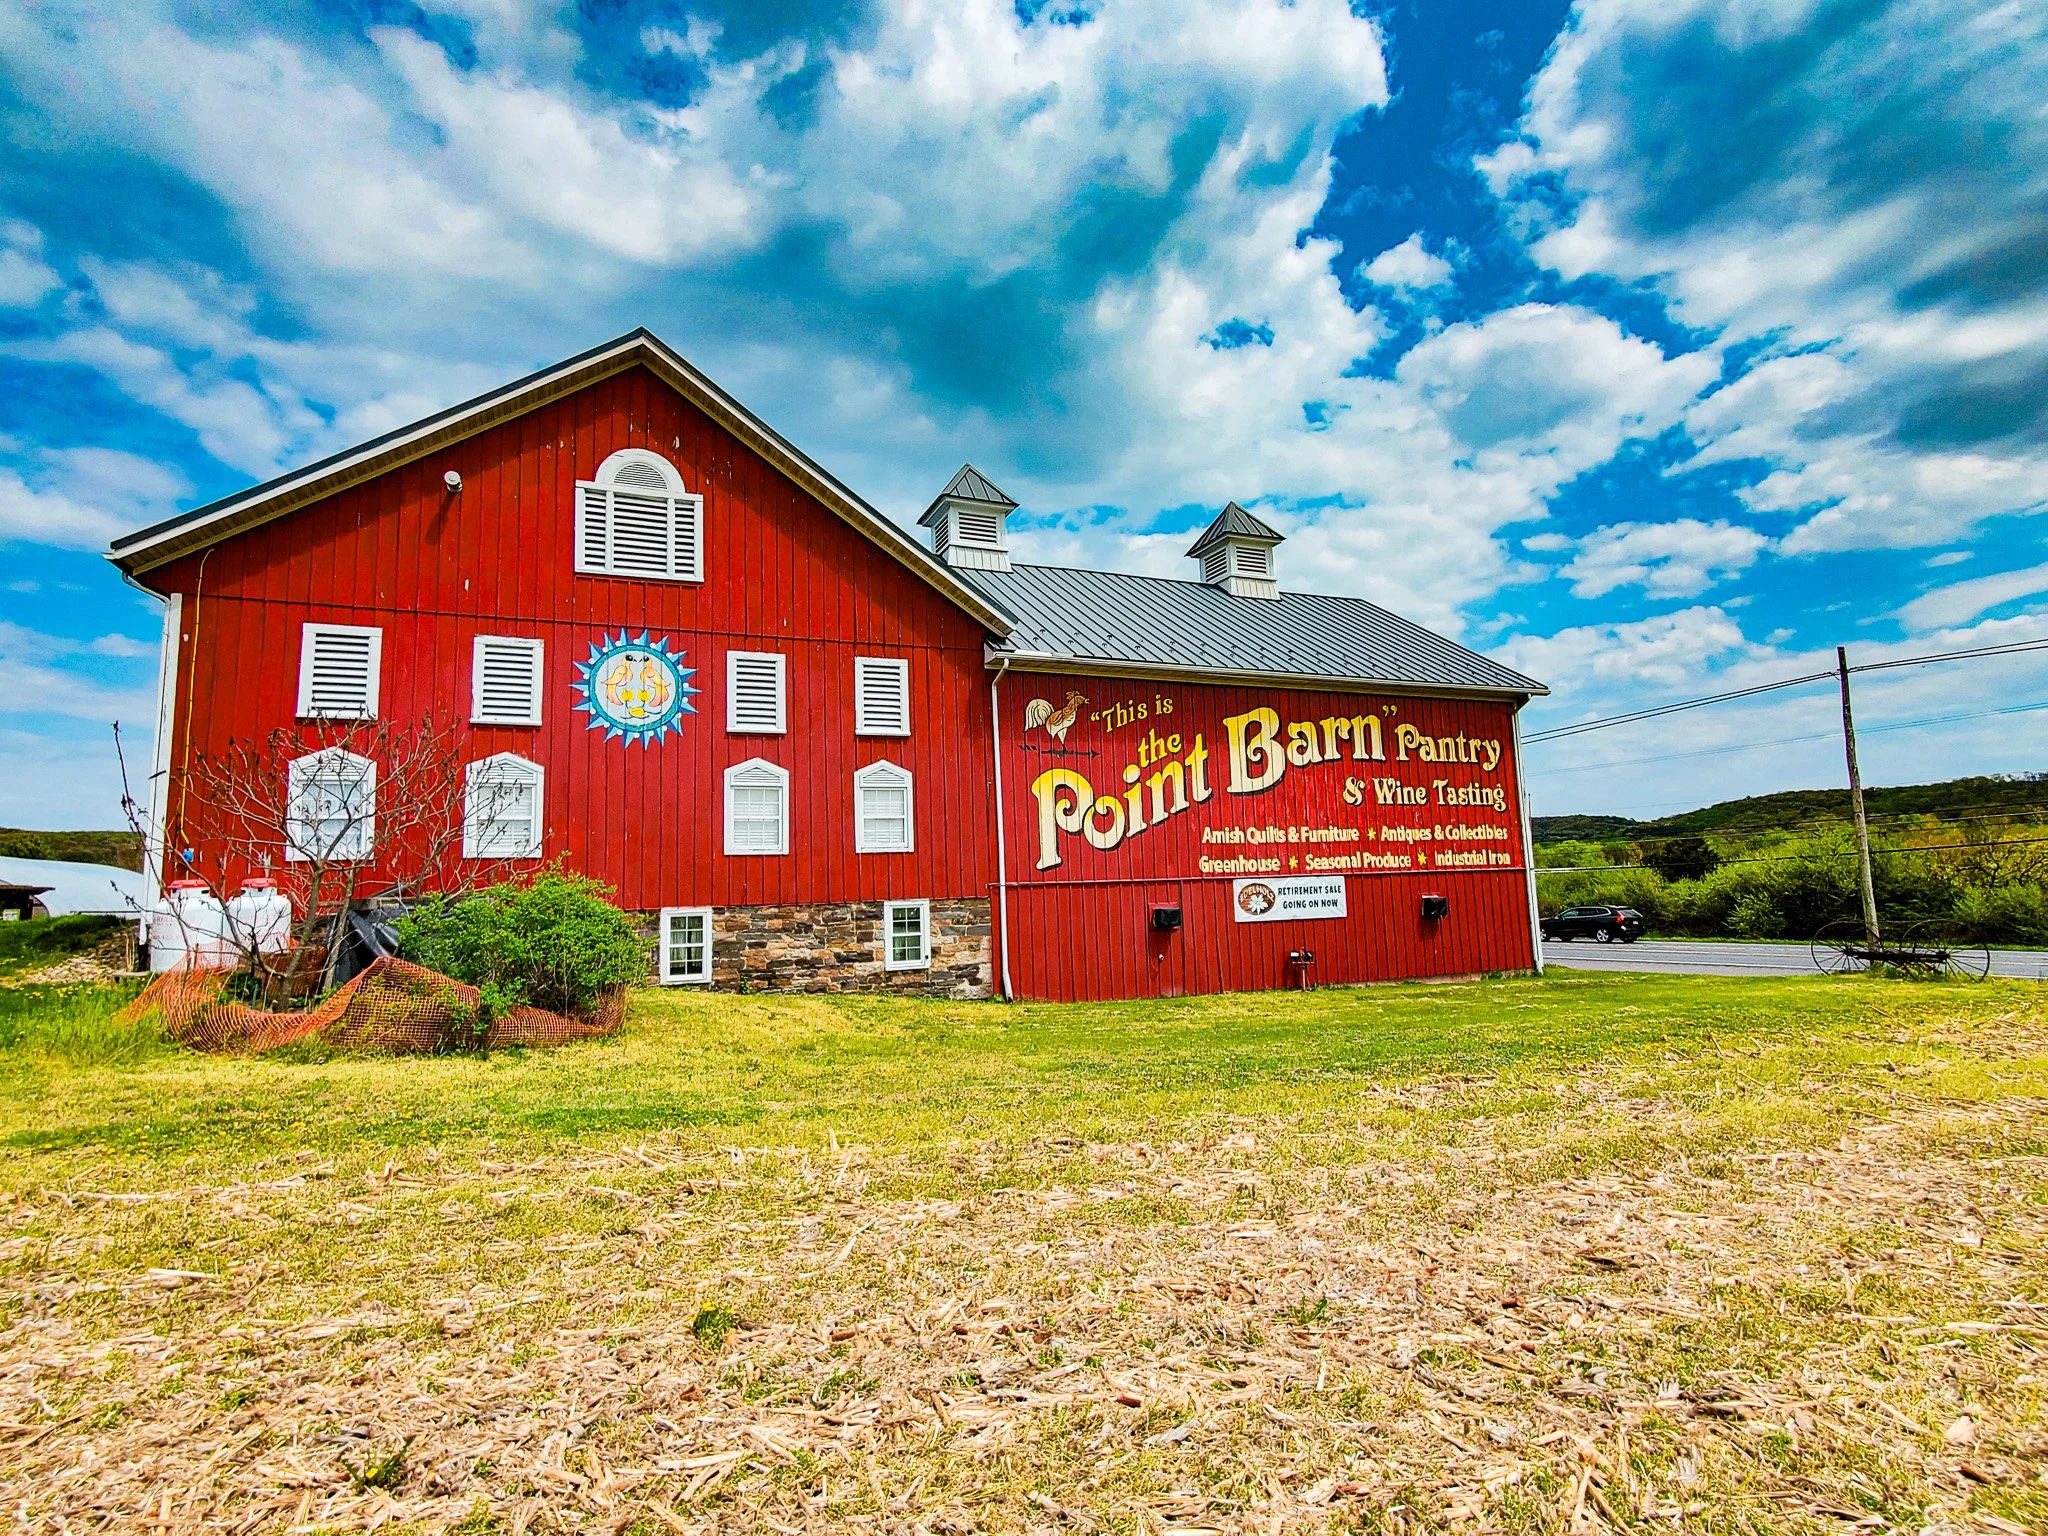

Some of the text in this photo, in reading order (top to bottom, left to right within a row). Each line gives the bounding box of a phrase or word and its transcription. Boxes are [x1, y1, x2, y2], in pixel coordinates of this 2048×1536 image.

[1155, 694, 1173, 715] is
[1138, 728, 1182, 768] the
[1395, 723, 1500, 771] Pantry
[1031, 733, 1212, 870] Point
[1343, 777, 1506, 811] & Wine Tasting
[1202, 824, 1507, 845] Amish Quilts & Furniture Antiques & Collectibles
[1199, 849, 1510, 873] Greenhouse Seasonal Produce Industrial Iron
[1278, 885, 1341, 896] RETIREMENT SALE
[1283, 899, 1338, 909] GOING ON NOW
